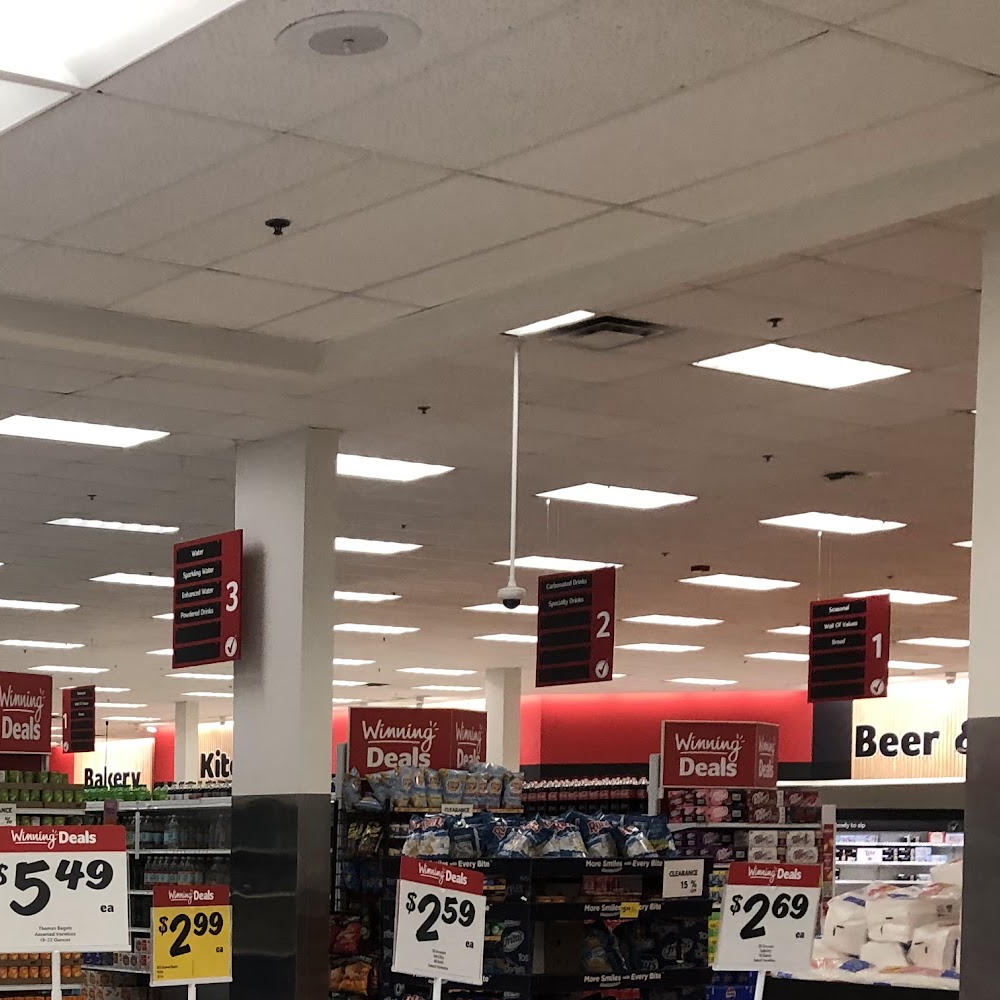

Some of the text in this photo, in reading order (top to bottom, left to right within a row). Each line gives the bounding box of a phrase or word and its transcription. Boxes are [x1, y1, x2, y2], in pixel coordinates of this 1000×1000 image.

[191, 548, 204, 557] Water
[182, 566, 214, 580] Sparkling Water
[182, 586, 214, 599] Enhanced Water
[546, 578, 588, 590] Carbonated Drinks
[226, 580, 239, 612] 3
[548, 596, 584, 608] Specialty Drinks
[180, 607, 214, 619] Powdered Drinks
[596, 610, 610, 638] 2
[824, 622, 834, 630] Wall
[842, 620, 858, 628] Values
[872, 632, 882, 658] 1
[0, 684, 46, 723] Winning
[1, 716, 41, 741] Deals
[362, 719, 438, 752] Winning
[456, 722, 483, 752] Winning
[675, 732, 743, 762] Winning
[855, 724, 940, 758] Beer
[200, 749, 233, 779] Kit
[367, 746, 431, 768] Deals
[457, 748, 480, 768] Deals
[679, 756, 738, 777] Deals
[84, 766, 142, 788] Bakery
[758, 759, 774, 778] Deals
[11, 829, 96, 850] Winning Deals
[418, 862, 468, 886] Winning Deals
[458, 860, 490, 868] Every Bite
[632, 860, 650, 868] Every
[680, 880, 697, 889] 15 %
[748, 865, 802, 884] Winning Deals
[168, 890, 214, 905] Winning Deals
[100, 904, 114, 913] ea
[601, 974, 621, 982] Smiles
[631, 973, 649, 982] Every
[650, 972, 662, 980] Bite
